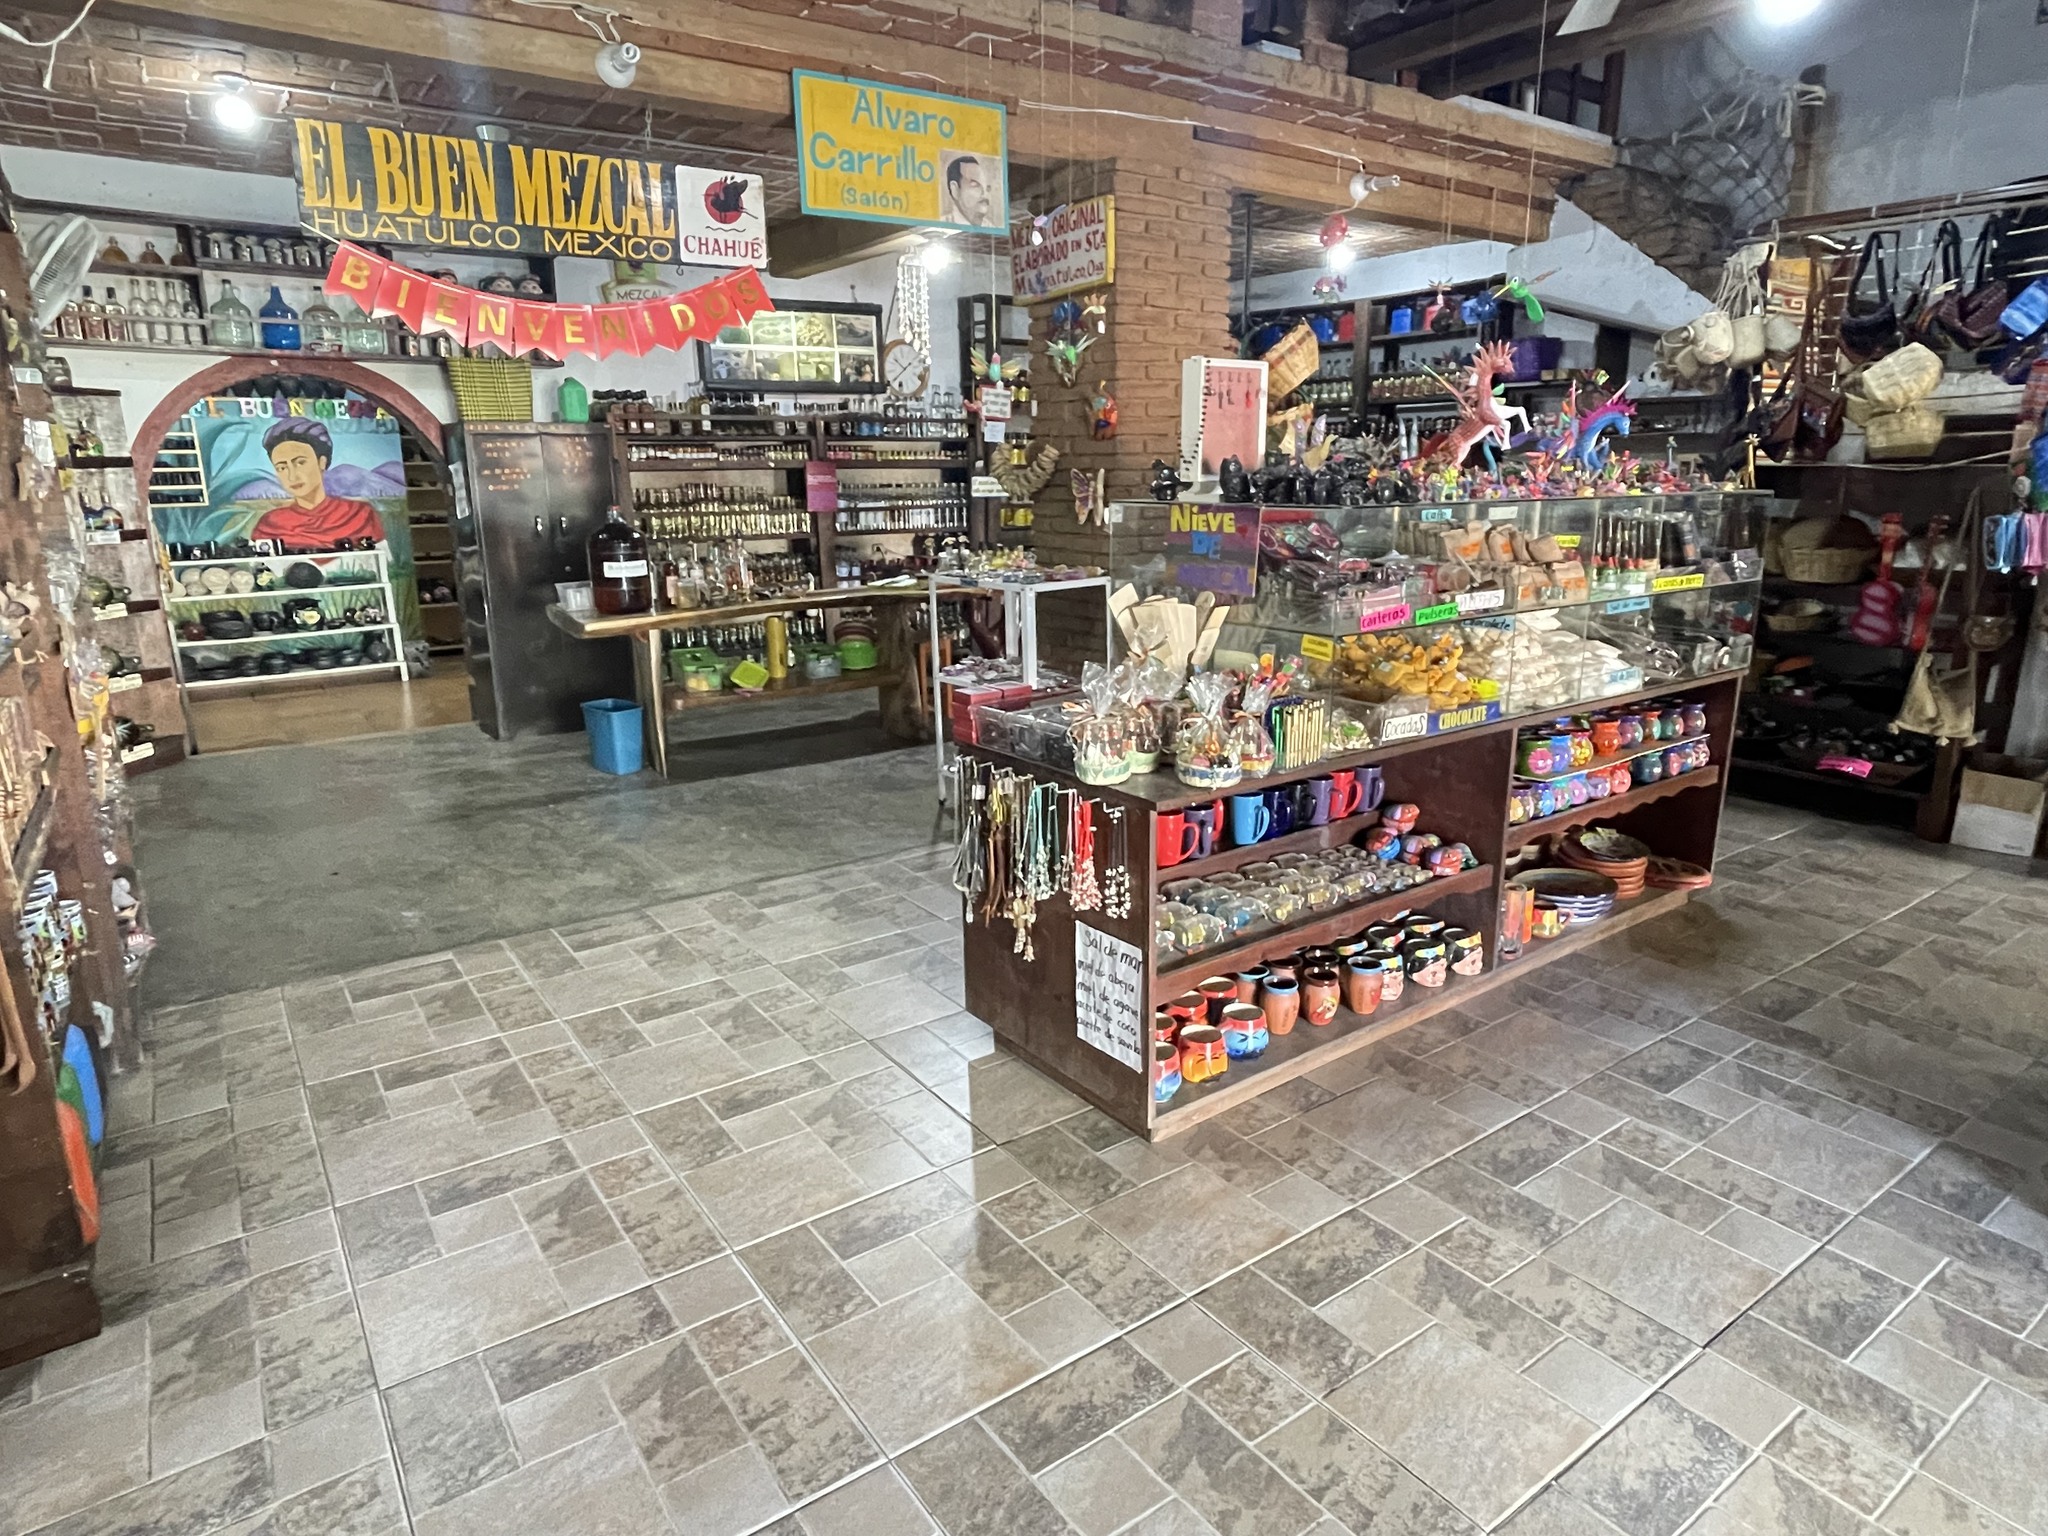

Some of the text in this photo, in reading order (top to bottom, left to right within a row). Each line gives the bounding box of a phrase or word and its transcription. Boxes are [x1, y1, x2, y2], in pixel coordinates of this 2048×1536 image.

[851, 88, 955, 139] Alvaro
[809, 131, 935, 182] Carrillo
[294, 118, 676, 239] EL BUEN MEZCAL
[840, 183, 910, 213] (Salón)
[313, 209, 673, 262] HUATULCO MEXICO
[1052, 201, 1104, 238] ORIGINAL
[683, 233, 764, 260] CHAHUÉ
[340, 255, 760, 344] BIENVENIDOS
[1439, 704, 1488, 730] CHOCOLATE
[1082, 930, 1143, 974] Sal de mar
[1078, 981, 1096, 999] miel
[1117, 1020, 1137, 1037] coco
